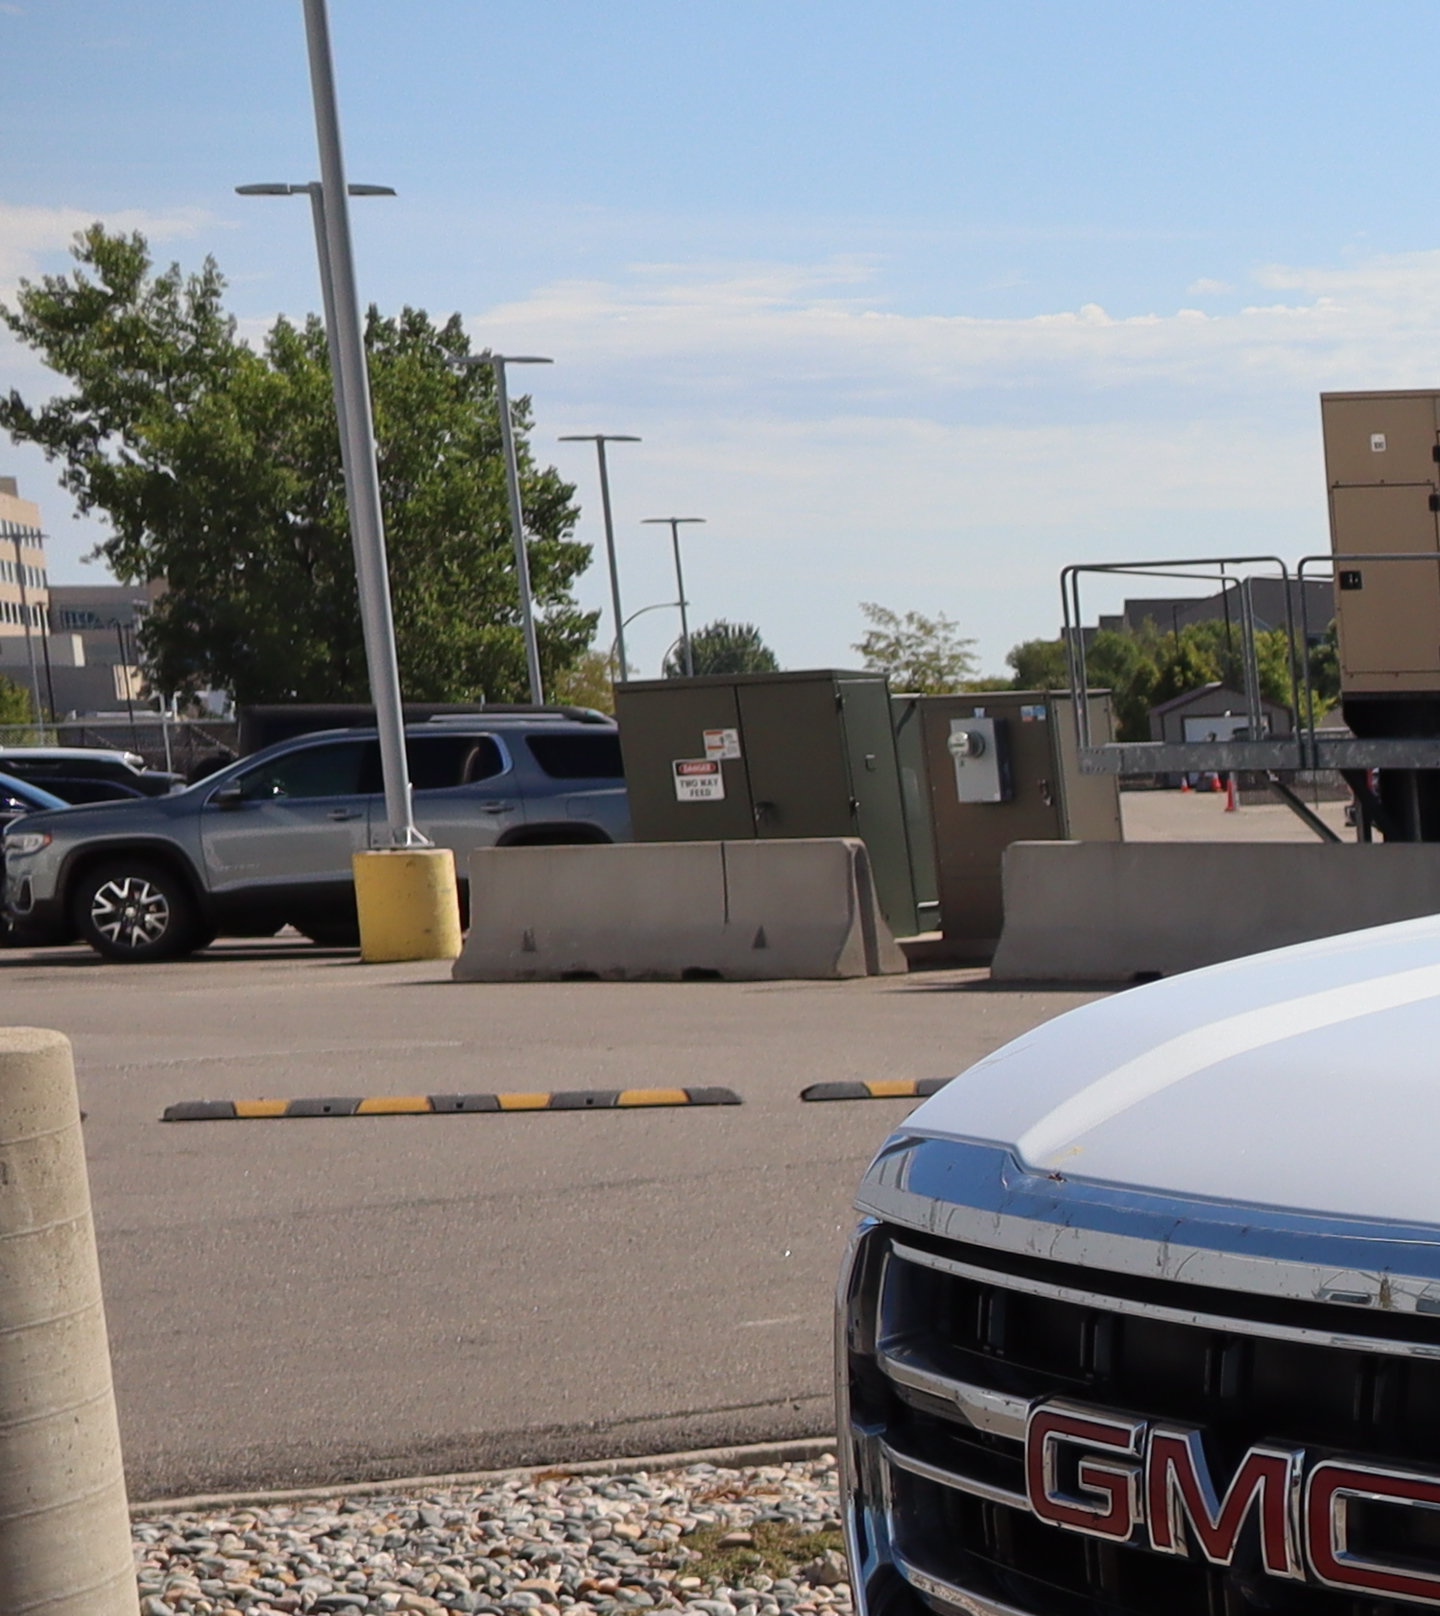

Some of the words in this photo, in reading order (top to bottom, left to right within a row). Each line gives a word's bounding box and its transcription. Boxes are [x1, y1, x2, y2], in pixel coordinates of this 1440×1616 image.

[680, 780, 699, 788] TWO
[701, 778, 718, 786] WAY
[690, 788, 712, 797] FEED
